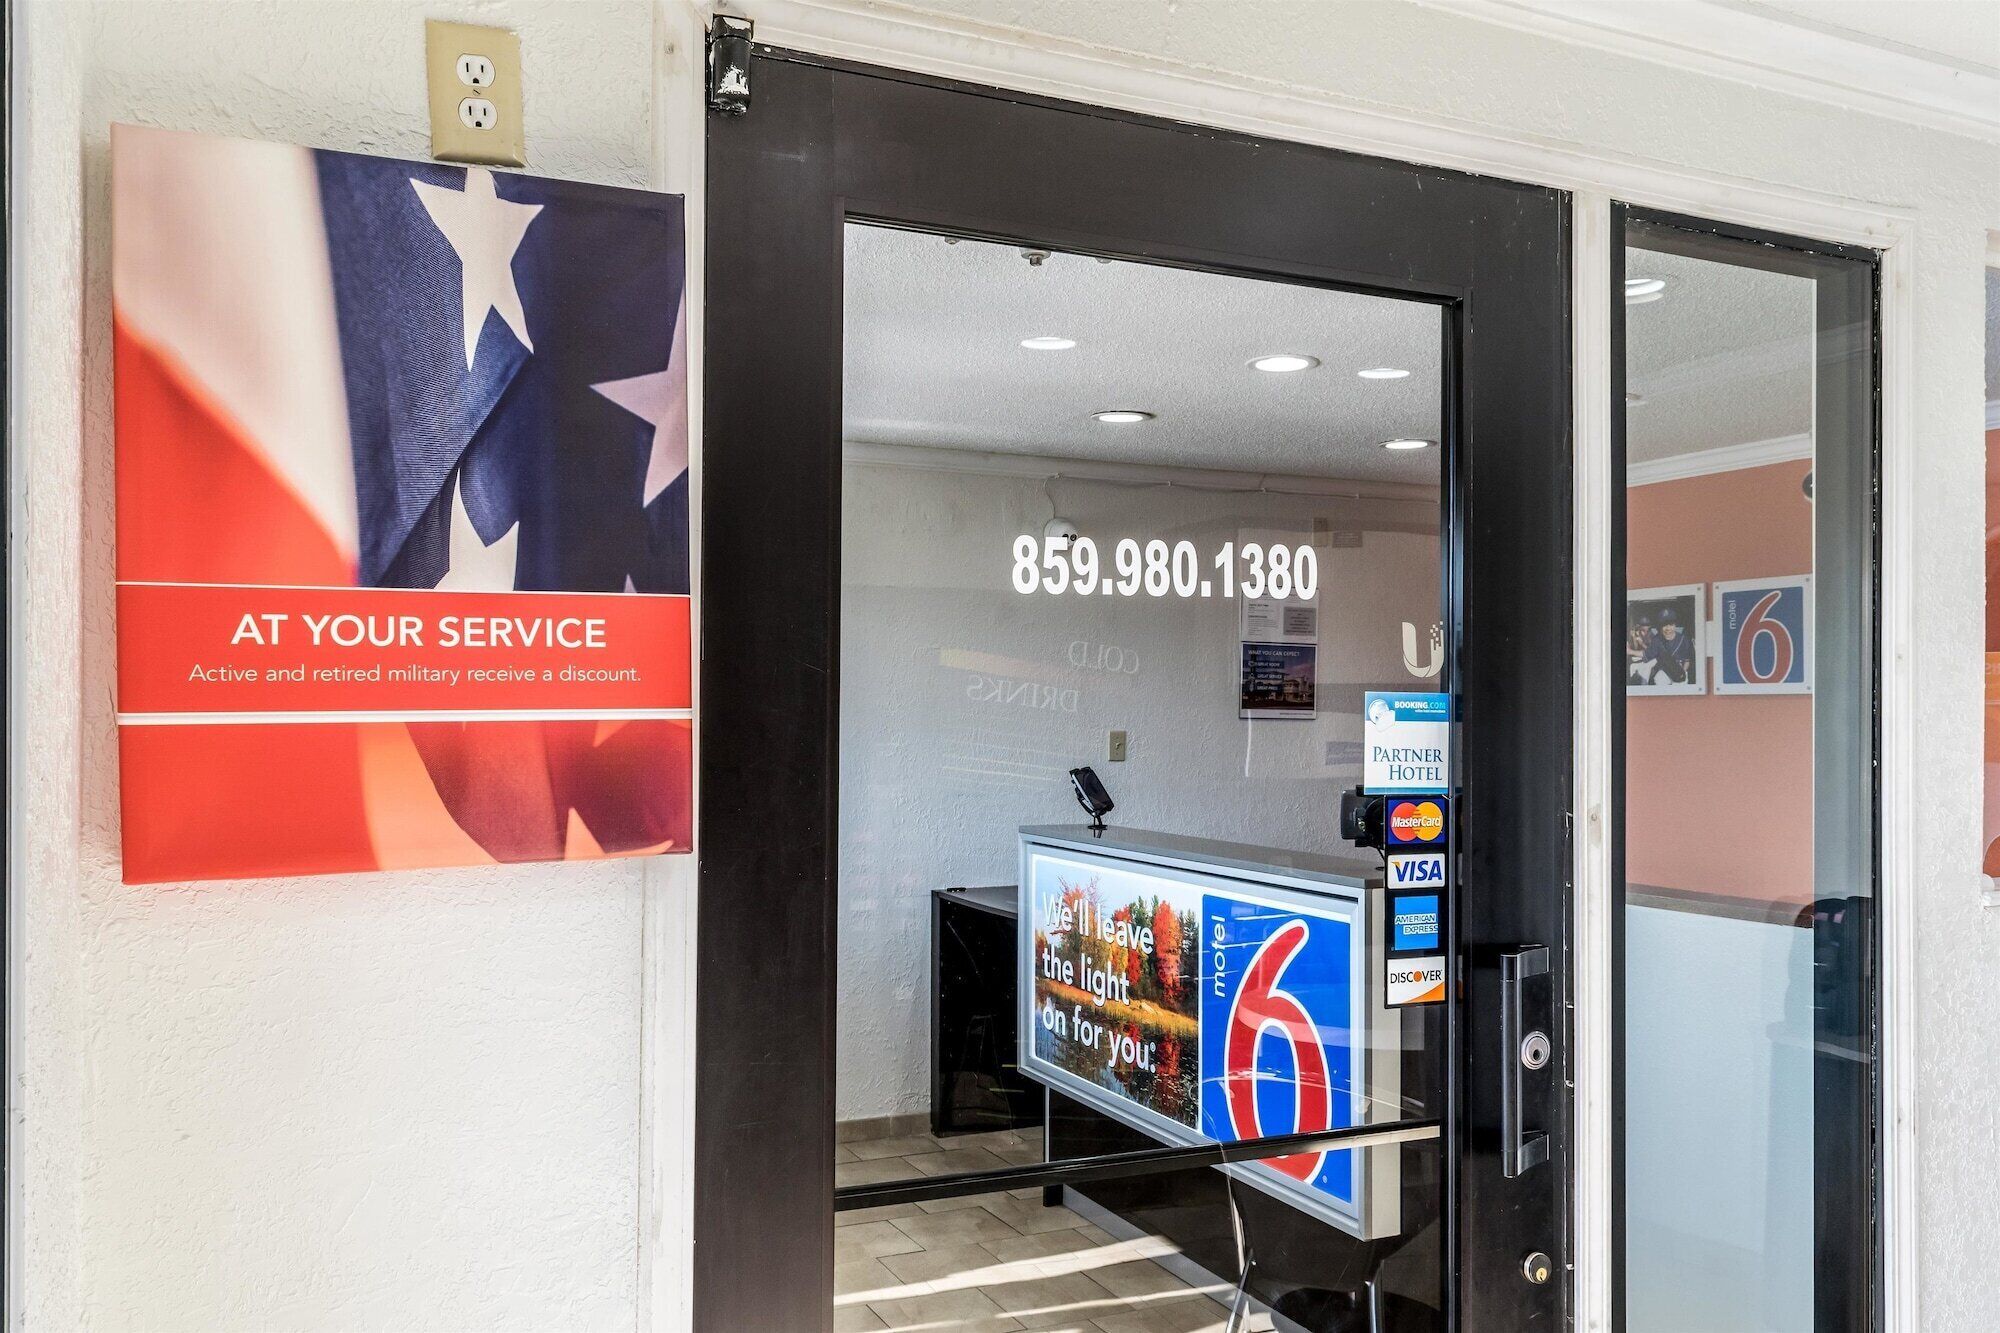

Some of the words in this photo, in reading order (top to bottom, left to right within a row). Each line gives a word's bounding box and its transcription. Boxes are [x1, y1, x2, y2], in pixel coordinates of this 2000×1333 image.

[1011, 534, 1319, 600] 859.980.1380
[230, 613, 289, 646] AT
[301, 614, 424, 648] YOUR
[438, 616, 607, 649] SERVICE
[1728, 599, 1737, 630] motel
[1736, 590, 1794, 685] 6
[188, 663, 259, 682] Active
[265, 664, 305, 682] and
[312, 664, 381, 682] retired
[388, 664, 460, 687] military
[467, 664, 536, 682] receive
[542, 668, 553, 682] a
[559, 664, 642, 682] discount.
[1394, 701, 1446, 710] BOOKING.COM
[1372, 746, 1444, 763] PARTNER
[1388, 764, 1443, 781] HOTEL
[1391, 815, 1442, 828] MasterCard
[1391, 860, 1442, 882] VISA
[1096, 902, 1155, 955] leave
[1394, 914, 1437, 924] AMERICAN
[1404, 924, 1439, 934] EXPRESS
[1042, 947, 1074, 986] the
[1080, 952, 1131, 1007] light
[1390, 970, 1443, 984] DISCOVER
[1042, 1004, 1066, 1037] on
[1072, 1004, 1103, 1050] for
[1211, 915, 1226, 998] motel
[1224, 918, 1333, 1186] 6
